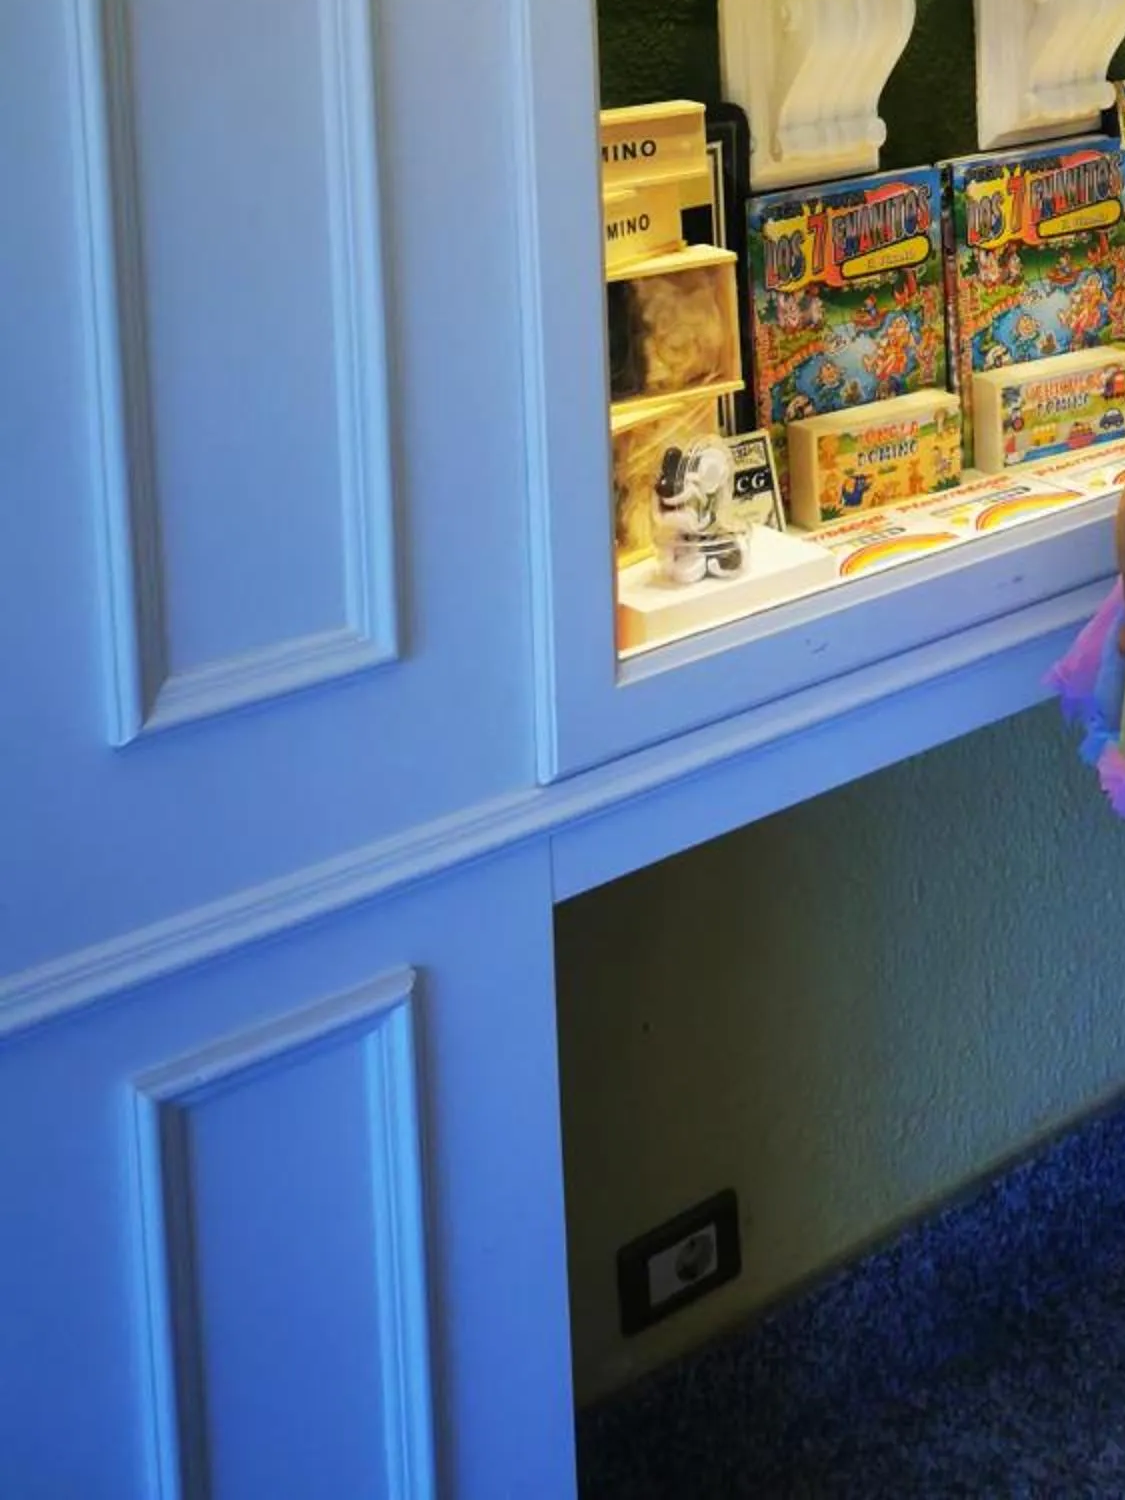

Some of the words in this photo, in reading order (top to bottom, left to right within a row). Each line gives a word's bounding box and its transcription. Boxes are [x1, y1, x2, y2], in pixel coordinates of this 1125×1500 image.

[606, 213, 650, 241] MINO
[966, 190, 1004, 245] LOS
[1006, 174, 1026, 233] 7
[1029, 151, 1123, 225] ENANITOS
[763, 228, 806, 289] LOS
[807, 212, 828, 276] 7
[831, 184, 931, 267] ENANITOS
[856, 438, 919, 466] DOMINO
